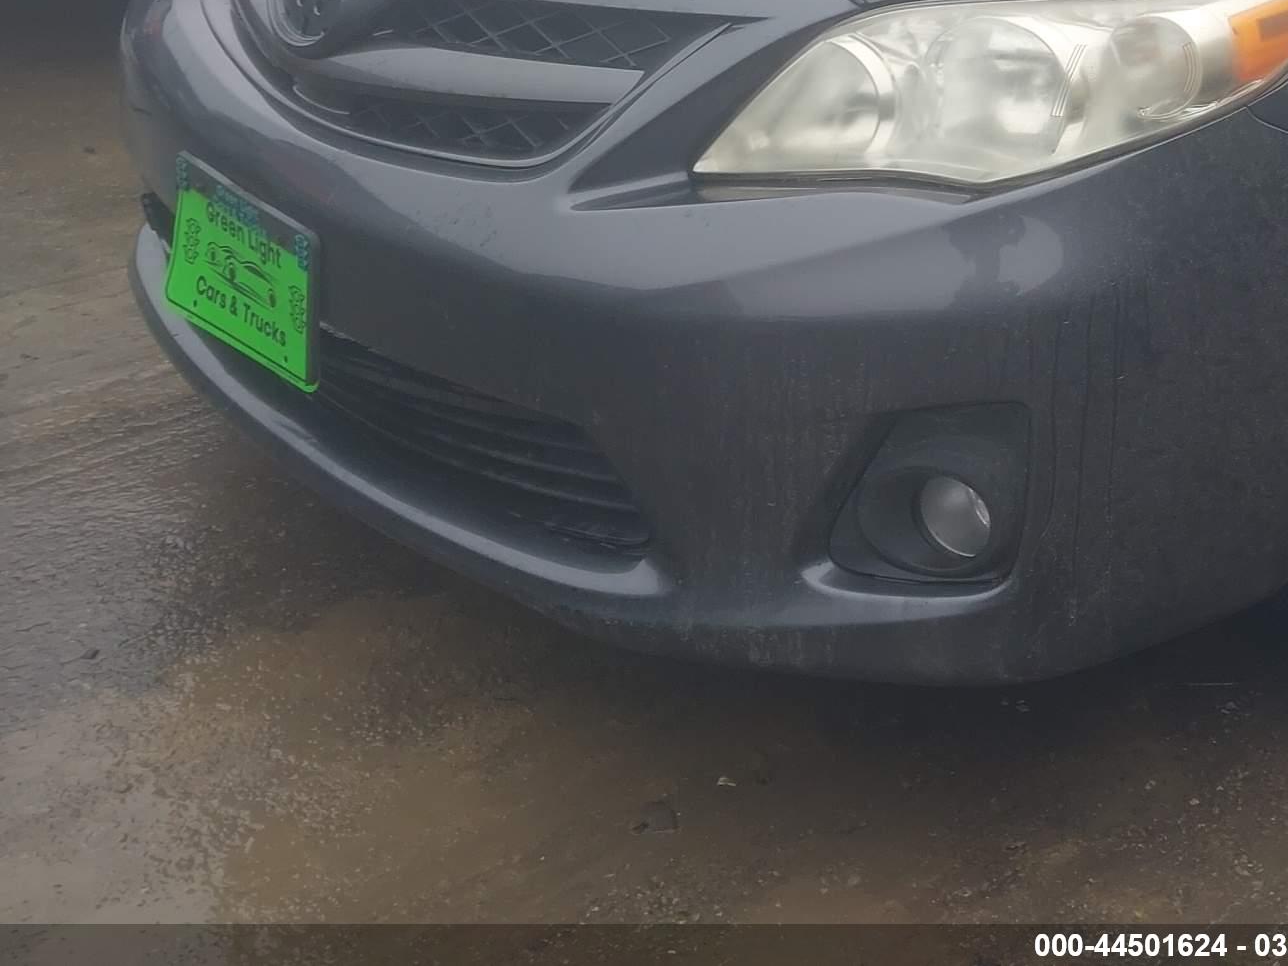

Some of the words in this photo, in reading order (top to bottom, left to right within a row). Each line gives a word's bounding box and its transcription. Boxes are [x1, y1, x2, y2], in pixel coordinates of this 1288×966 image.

[206, 201, 244, 242] Green
[247, 228, 282, 269] Light
[196, 274, 228, 310] Cars
[229, 295, 238, 316] &
[243, 302, 287, 347] Trucks
